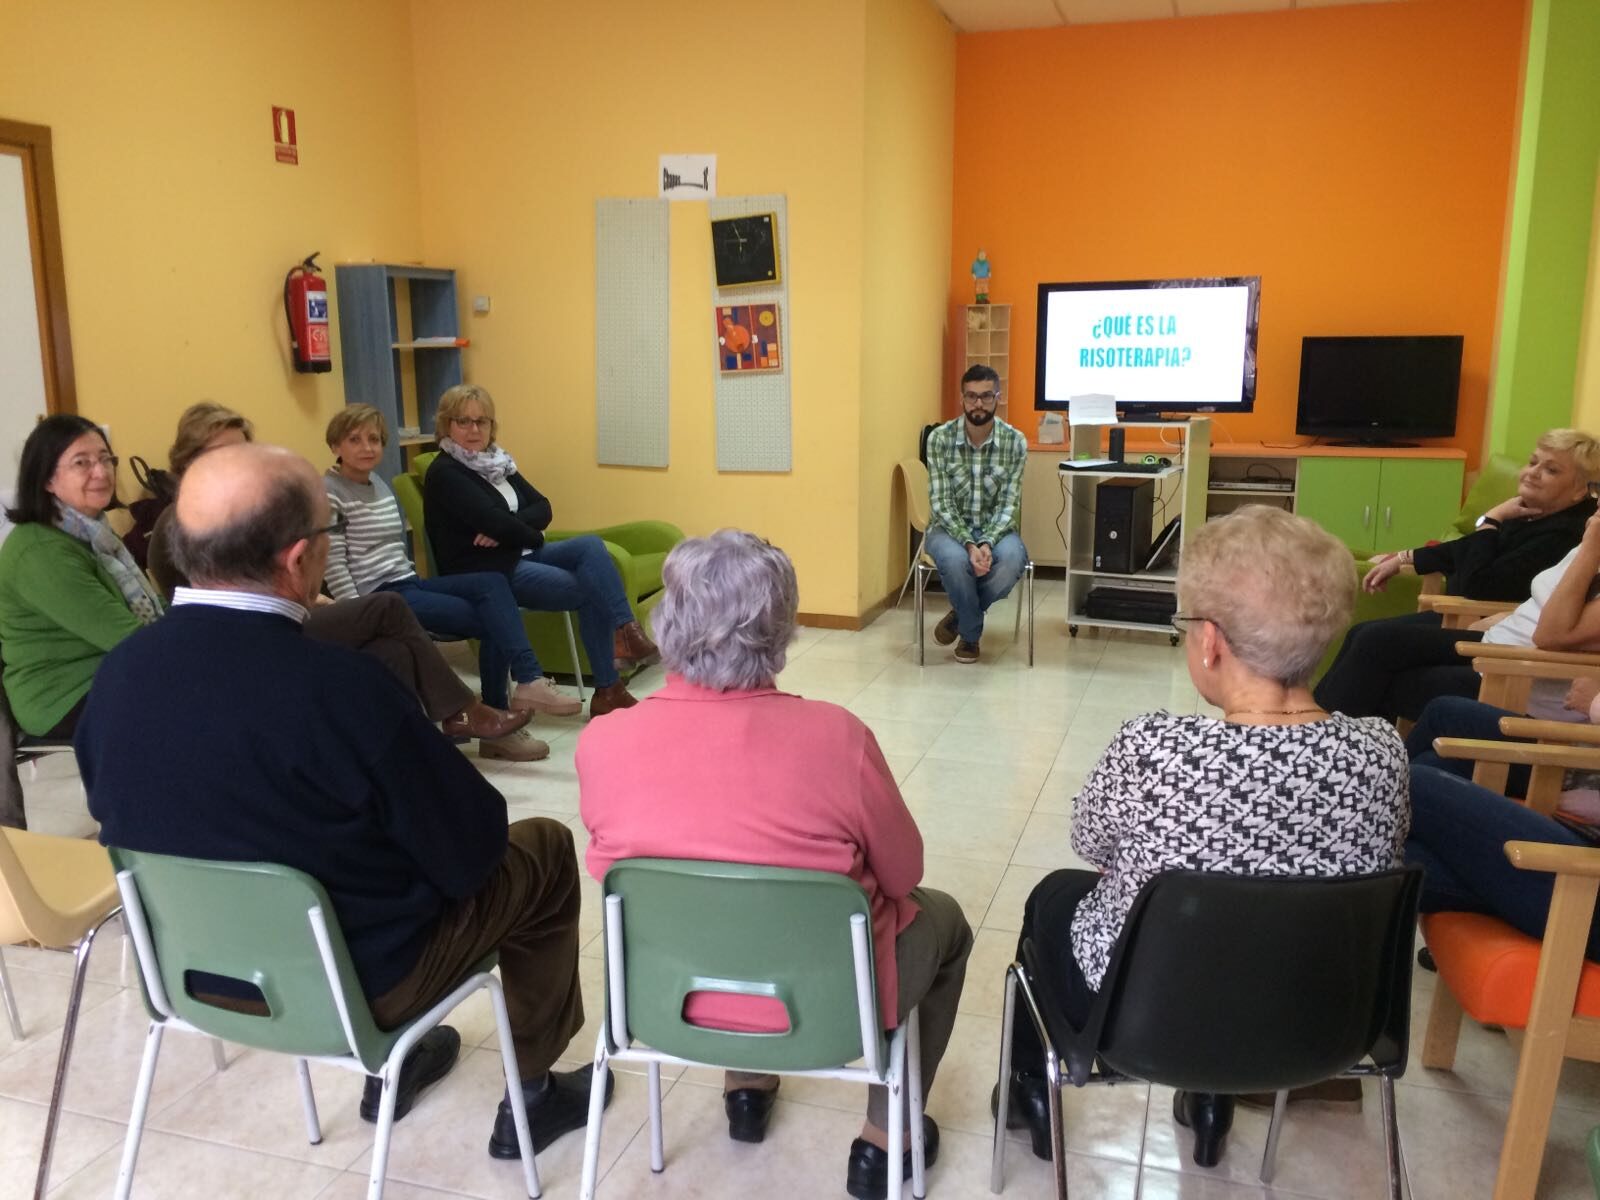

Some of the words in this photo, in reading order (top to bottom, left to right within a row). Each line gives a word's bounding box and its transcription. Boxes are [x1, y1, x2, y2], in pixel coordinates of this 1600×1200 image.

[1092, 313, 1132, 339] ¿QUÉ
[1136, 315, 1154, 336] ES
[1158, 315, 1177, 336] LA
[1079, 347, 1192, 368] RISOTERAPIA?
